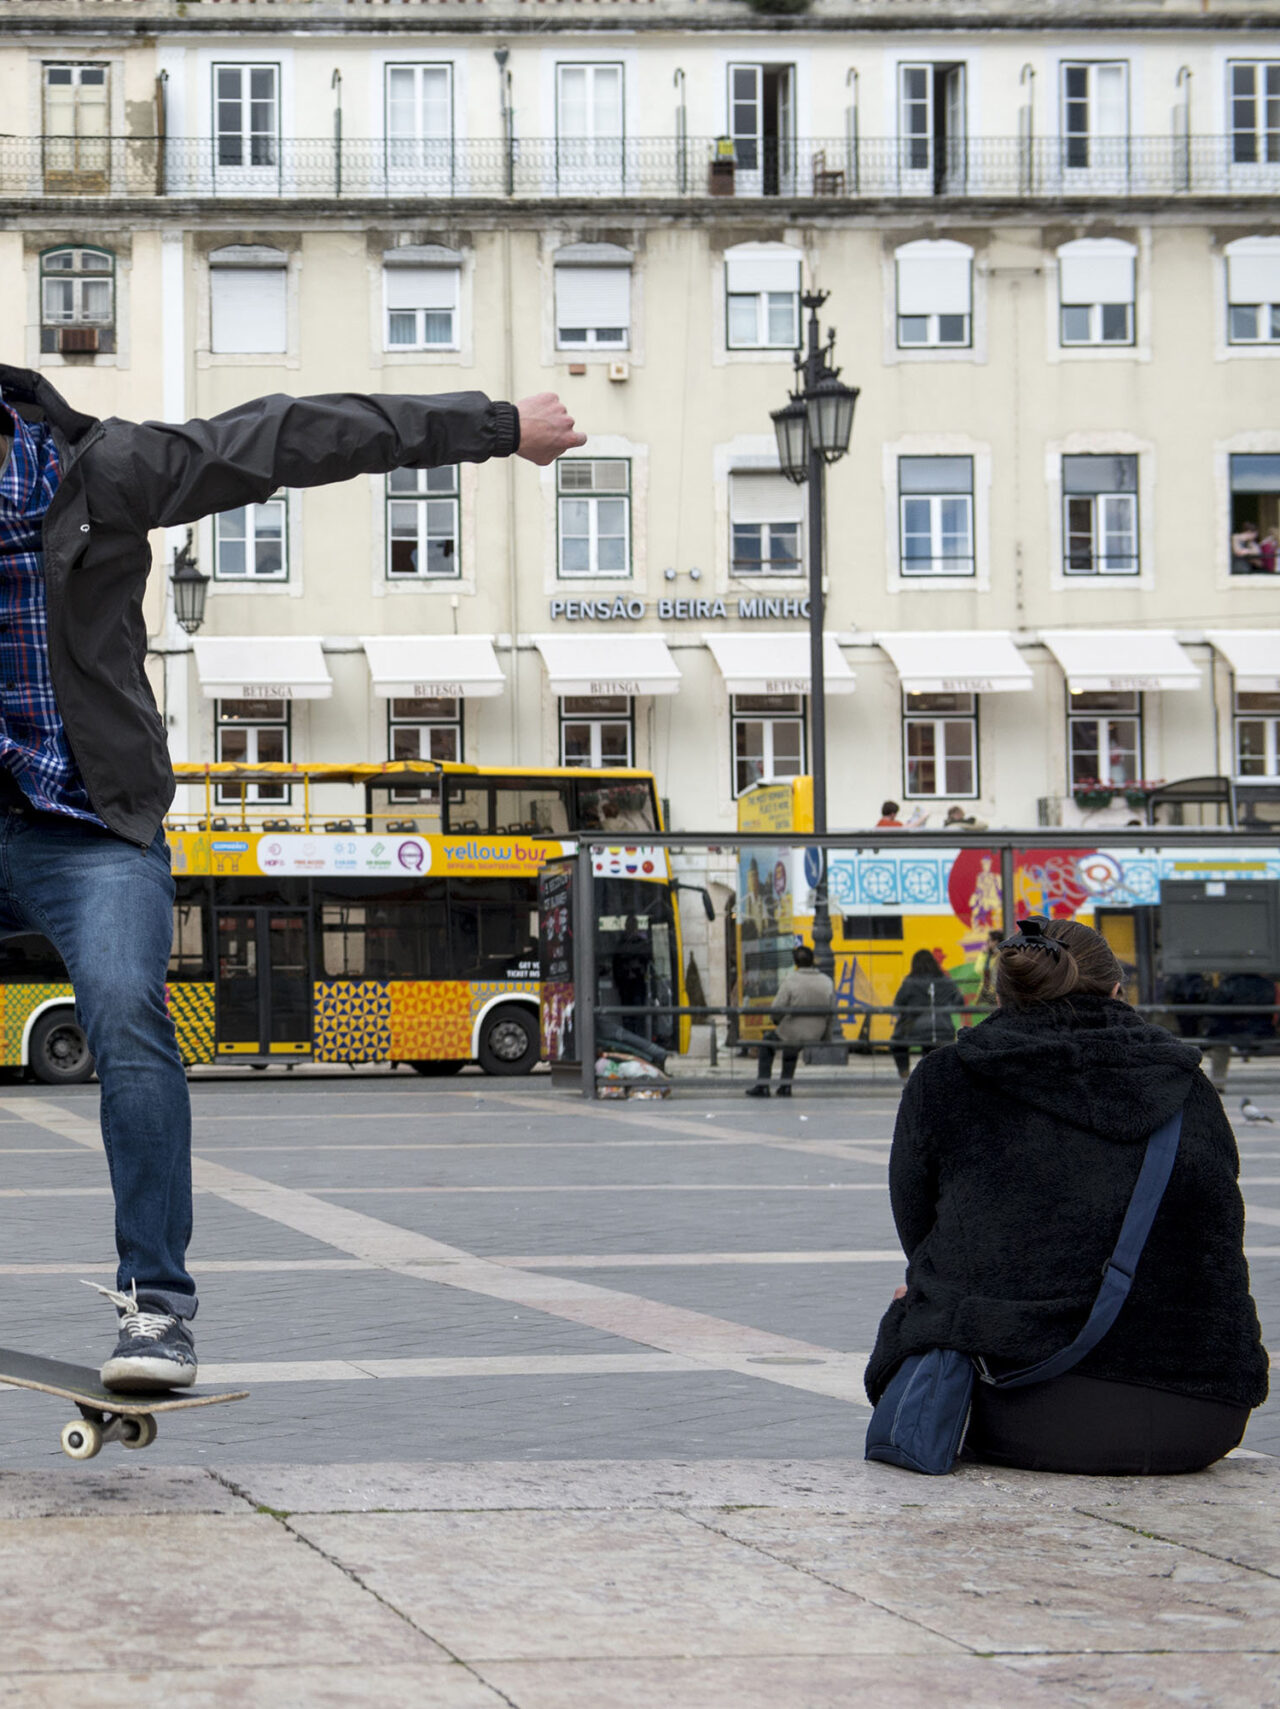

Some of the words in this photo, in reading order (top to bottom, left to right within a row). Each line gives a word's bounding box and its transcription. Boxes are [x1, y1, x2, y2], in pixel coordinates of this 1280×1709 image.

[550, 596, 645, 620] PENSÃO
[658, 597, 727, 619] BEIRA
[242, 685, 294, 697] BETESGA
[413, 684, 465, 696] BETESGA
[590, 682, 641, 694] BETESGA
[443, 841, 511, 860] yellow
